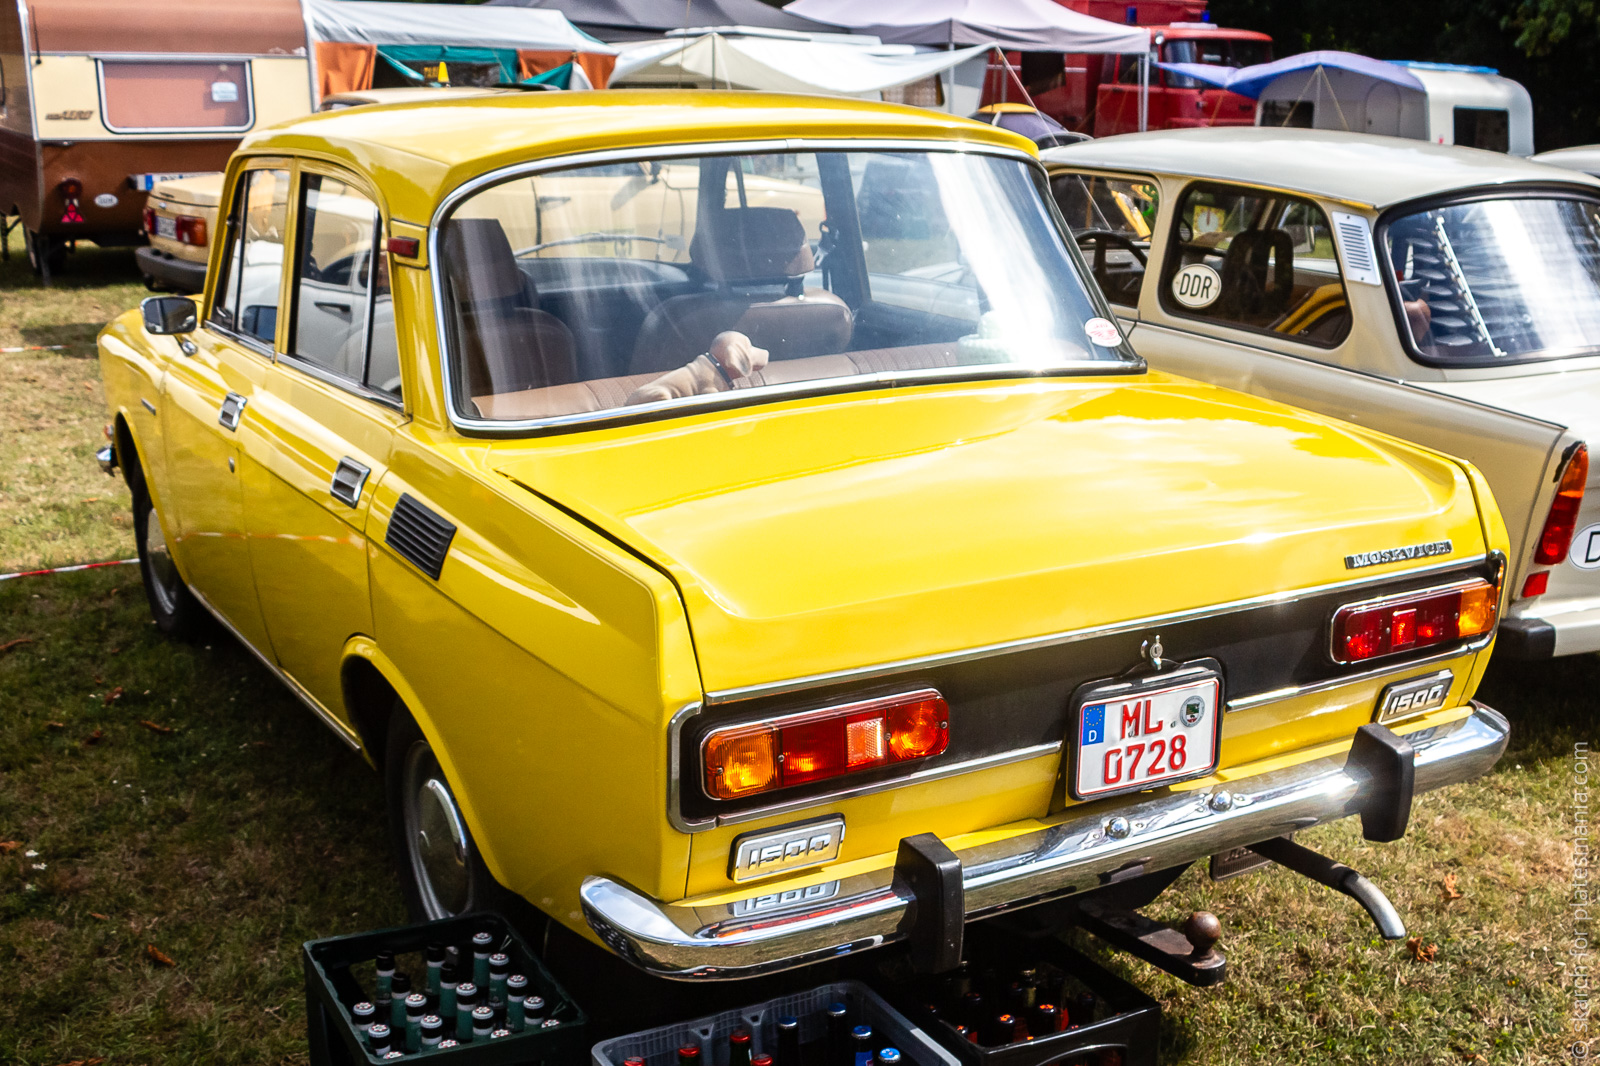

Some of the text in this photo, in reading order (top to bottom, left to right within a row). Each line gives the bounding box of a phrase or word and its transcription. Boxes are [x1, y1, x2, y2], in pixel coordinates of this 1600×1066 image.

[1179, 272, 1212, 299] DDR
[1352, 541, 1451, 568] MOSKVICH
[1388, 684, 1444, 715] 1500
[1120, 699, 1164, 740] ML
[1088, 730, 1097, 744] D
[1103, 734, 1187, 785] 0728
[748, 833, 832, 870] 1500
